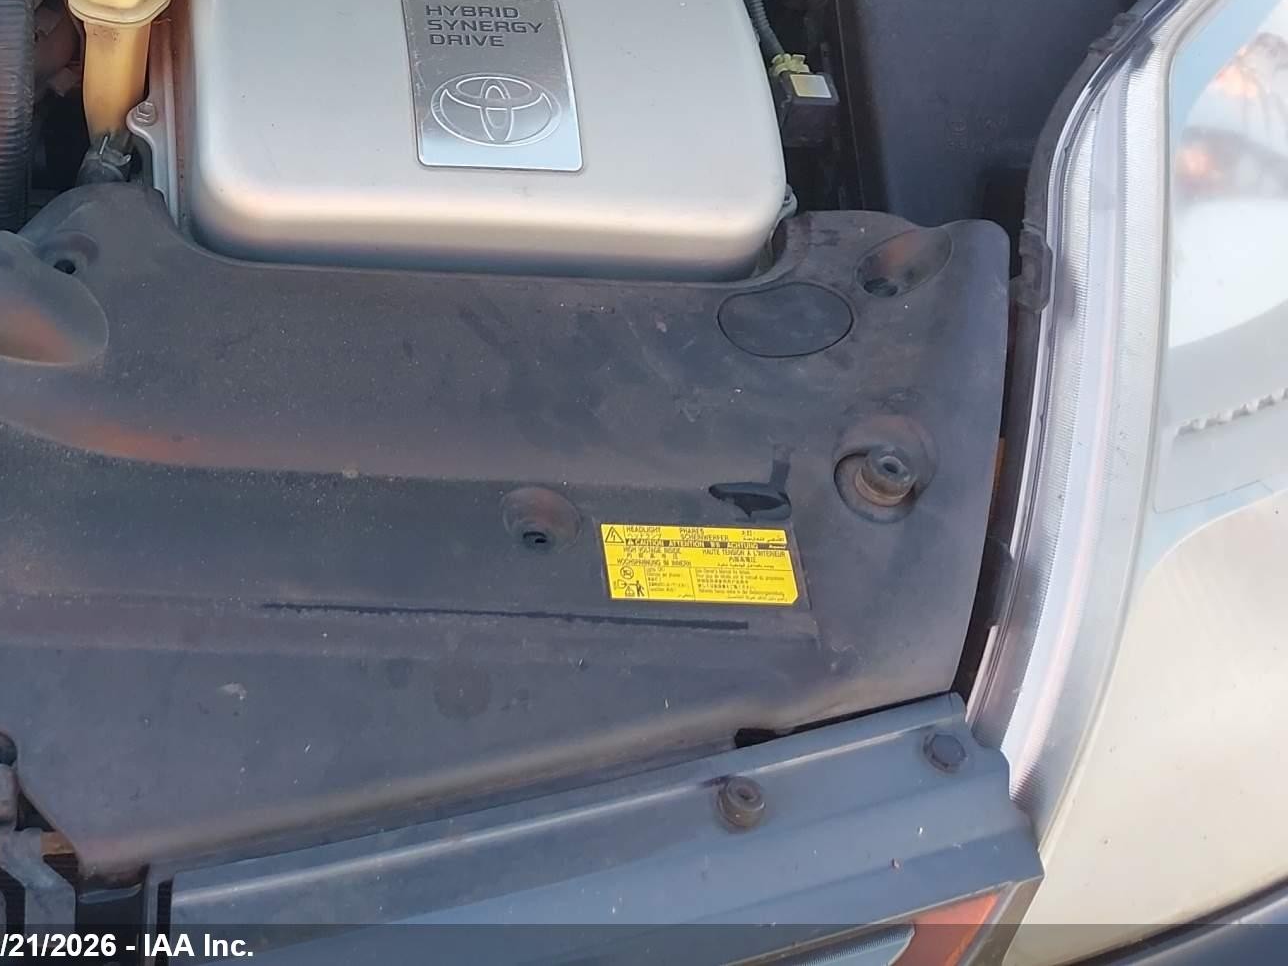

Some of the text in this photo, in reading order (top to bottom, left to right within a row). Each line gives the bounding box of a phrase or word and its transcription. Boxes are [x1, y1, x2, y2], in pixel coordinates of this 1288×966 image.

[425, 4, 519, 18] HYBRID
[427, 19, 544, 34] SYNERGY
[430, 34, 505, 47] DRIVE
[635, 538, 664, 546] CAUTION
[669, 540, 705, 548] ATTENTION
